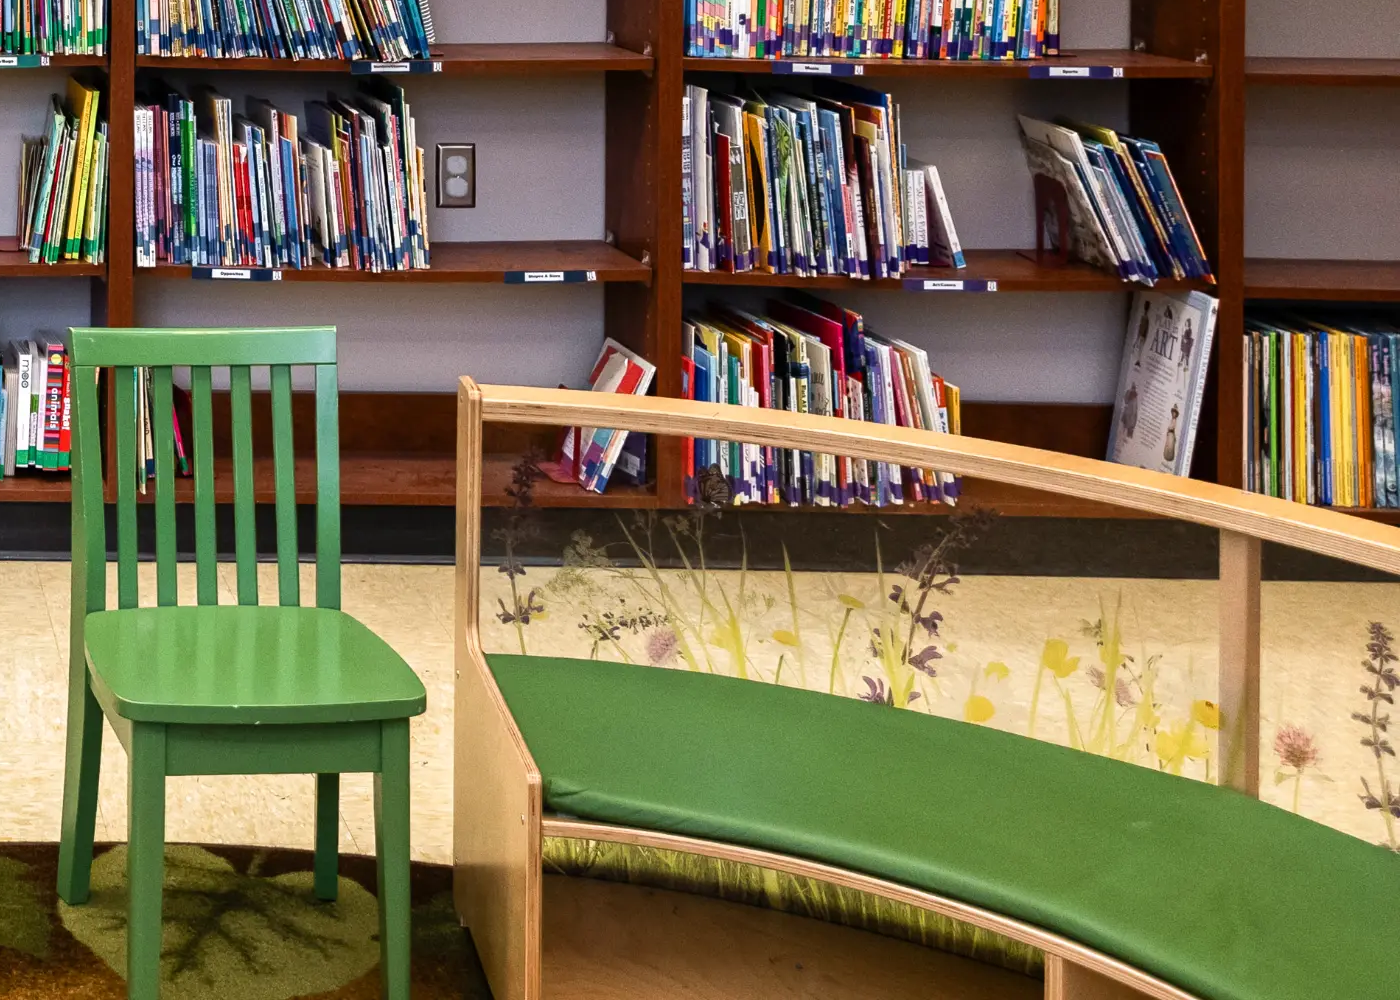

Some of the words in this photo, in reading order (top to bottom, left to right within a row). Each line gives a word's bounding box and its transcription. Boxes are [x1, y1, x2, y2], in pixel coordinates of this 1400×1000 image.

[1150, 328, 1178, 360] ART
[21, 359, 30, 389] moo
[49, 388, 61, 430] animals
[62, 397, 71, 430] snake!
